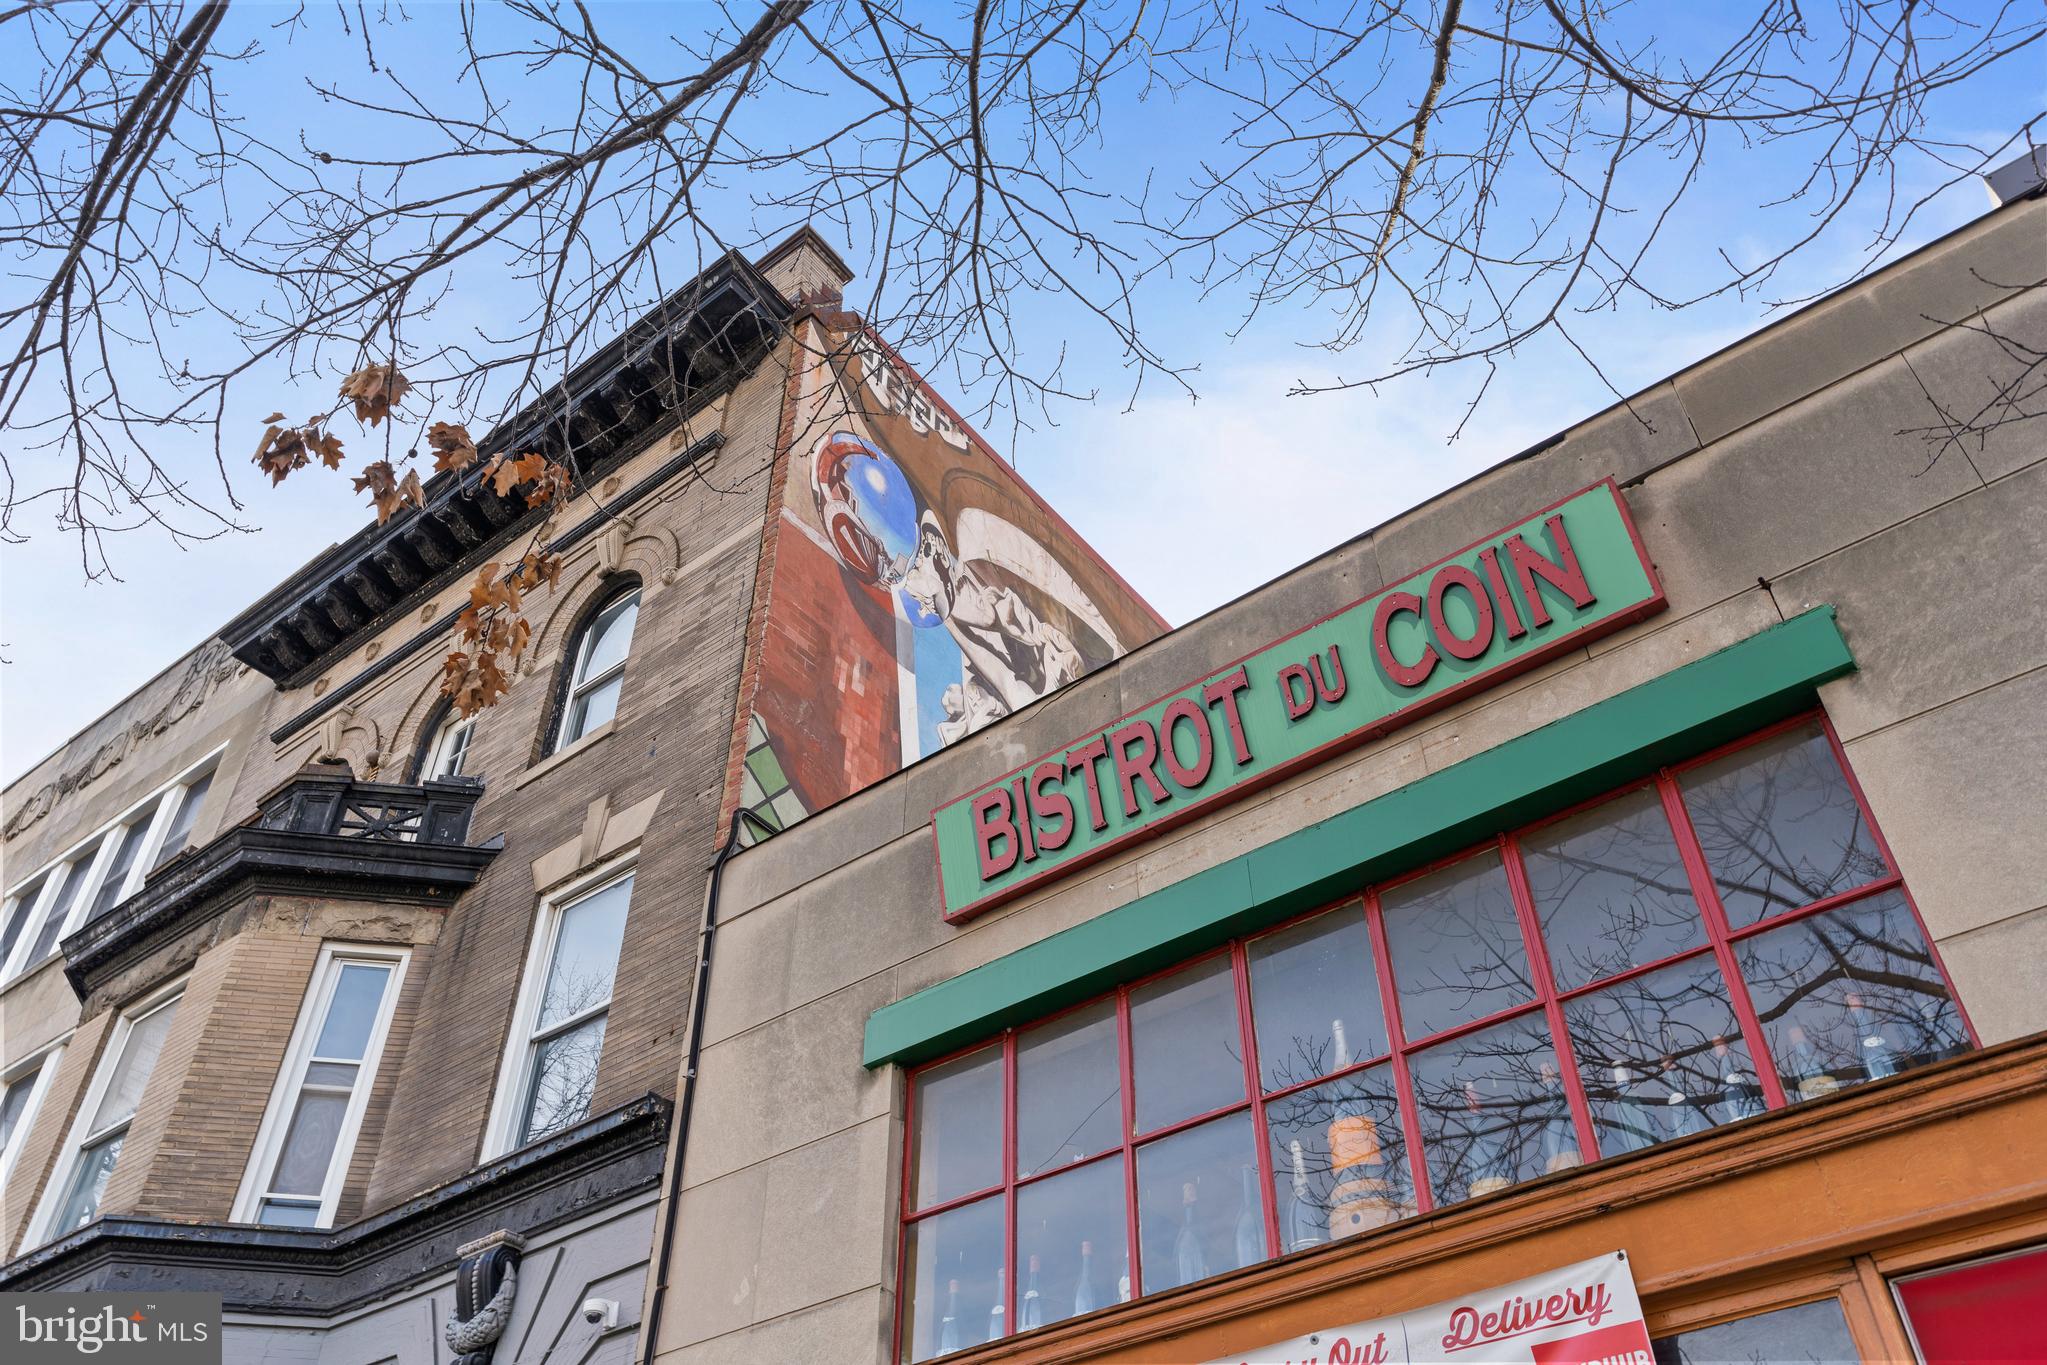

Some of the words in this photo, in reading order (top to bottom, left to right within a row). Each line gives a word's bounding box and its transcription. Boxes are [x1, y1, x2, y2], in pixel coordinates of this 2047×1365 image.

[971, 665, 1253, 882] BISTROT
[1278, 644, 1348, 721] DU
[1372, 513, 1597, 688] COIN
[1442, 1282, 1612, 1347] Delivery
